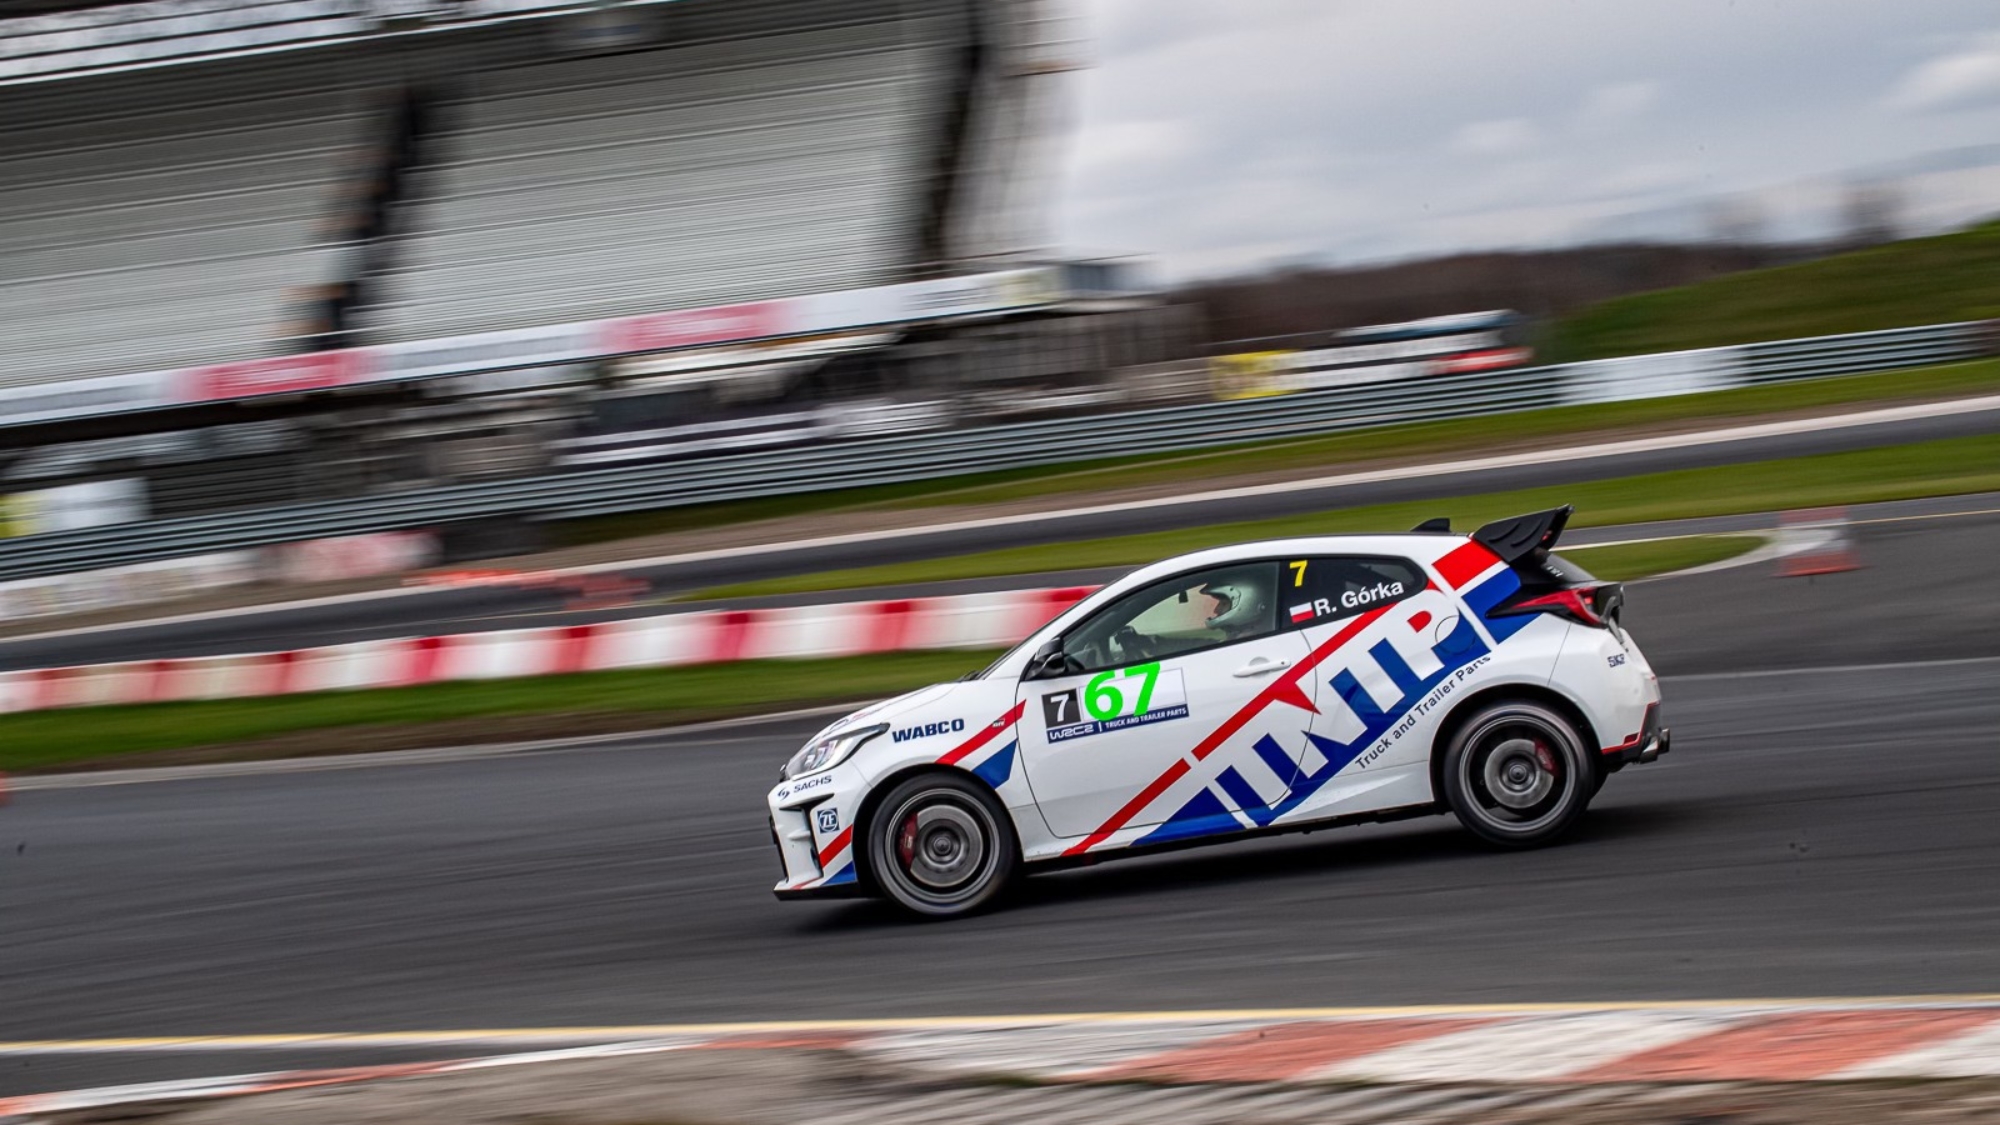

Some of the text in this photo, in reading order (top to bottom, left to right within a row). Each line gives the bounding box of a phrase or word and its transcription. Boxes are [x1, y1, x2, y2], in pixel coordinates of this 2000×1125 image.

[1289, 560, 1308, 587] 7
[1313, 582, 1404, 617] R. Górka
[1085, 662, 1160, 720] 67
[1050, 693, 1069, 722] 7
[1105, 718, 1126, 729] TRUCK
[1127, 715, 1140, 725] AND
[1140, 710, 1166, 722] TRAILER
[1167, 707, 1187, 718] PARTS
[1354, 657, 1491, 769] Truck and Trailer Parts
[892, 718, 965, 743] WABCO
[793, 775, 832, 793] SACHS
[819, 811, 838, 830] ZF
